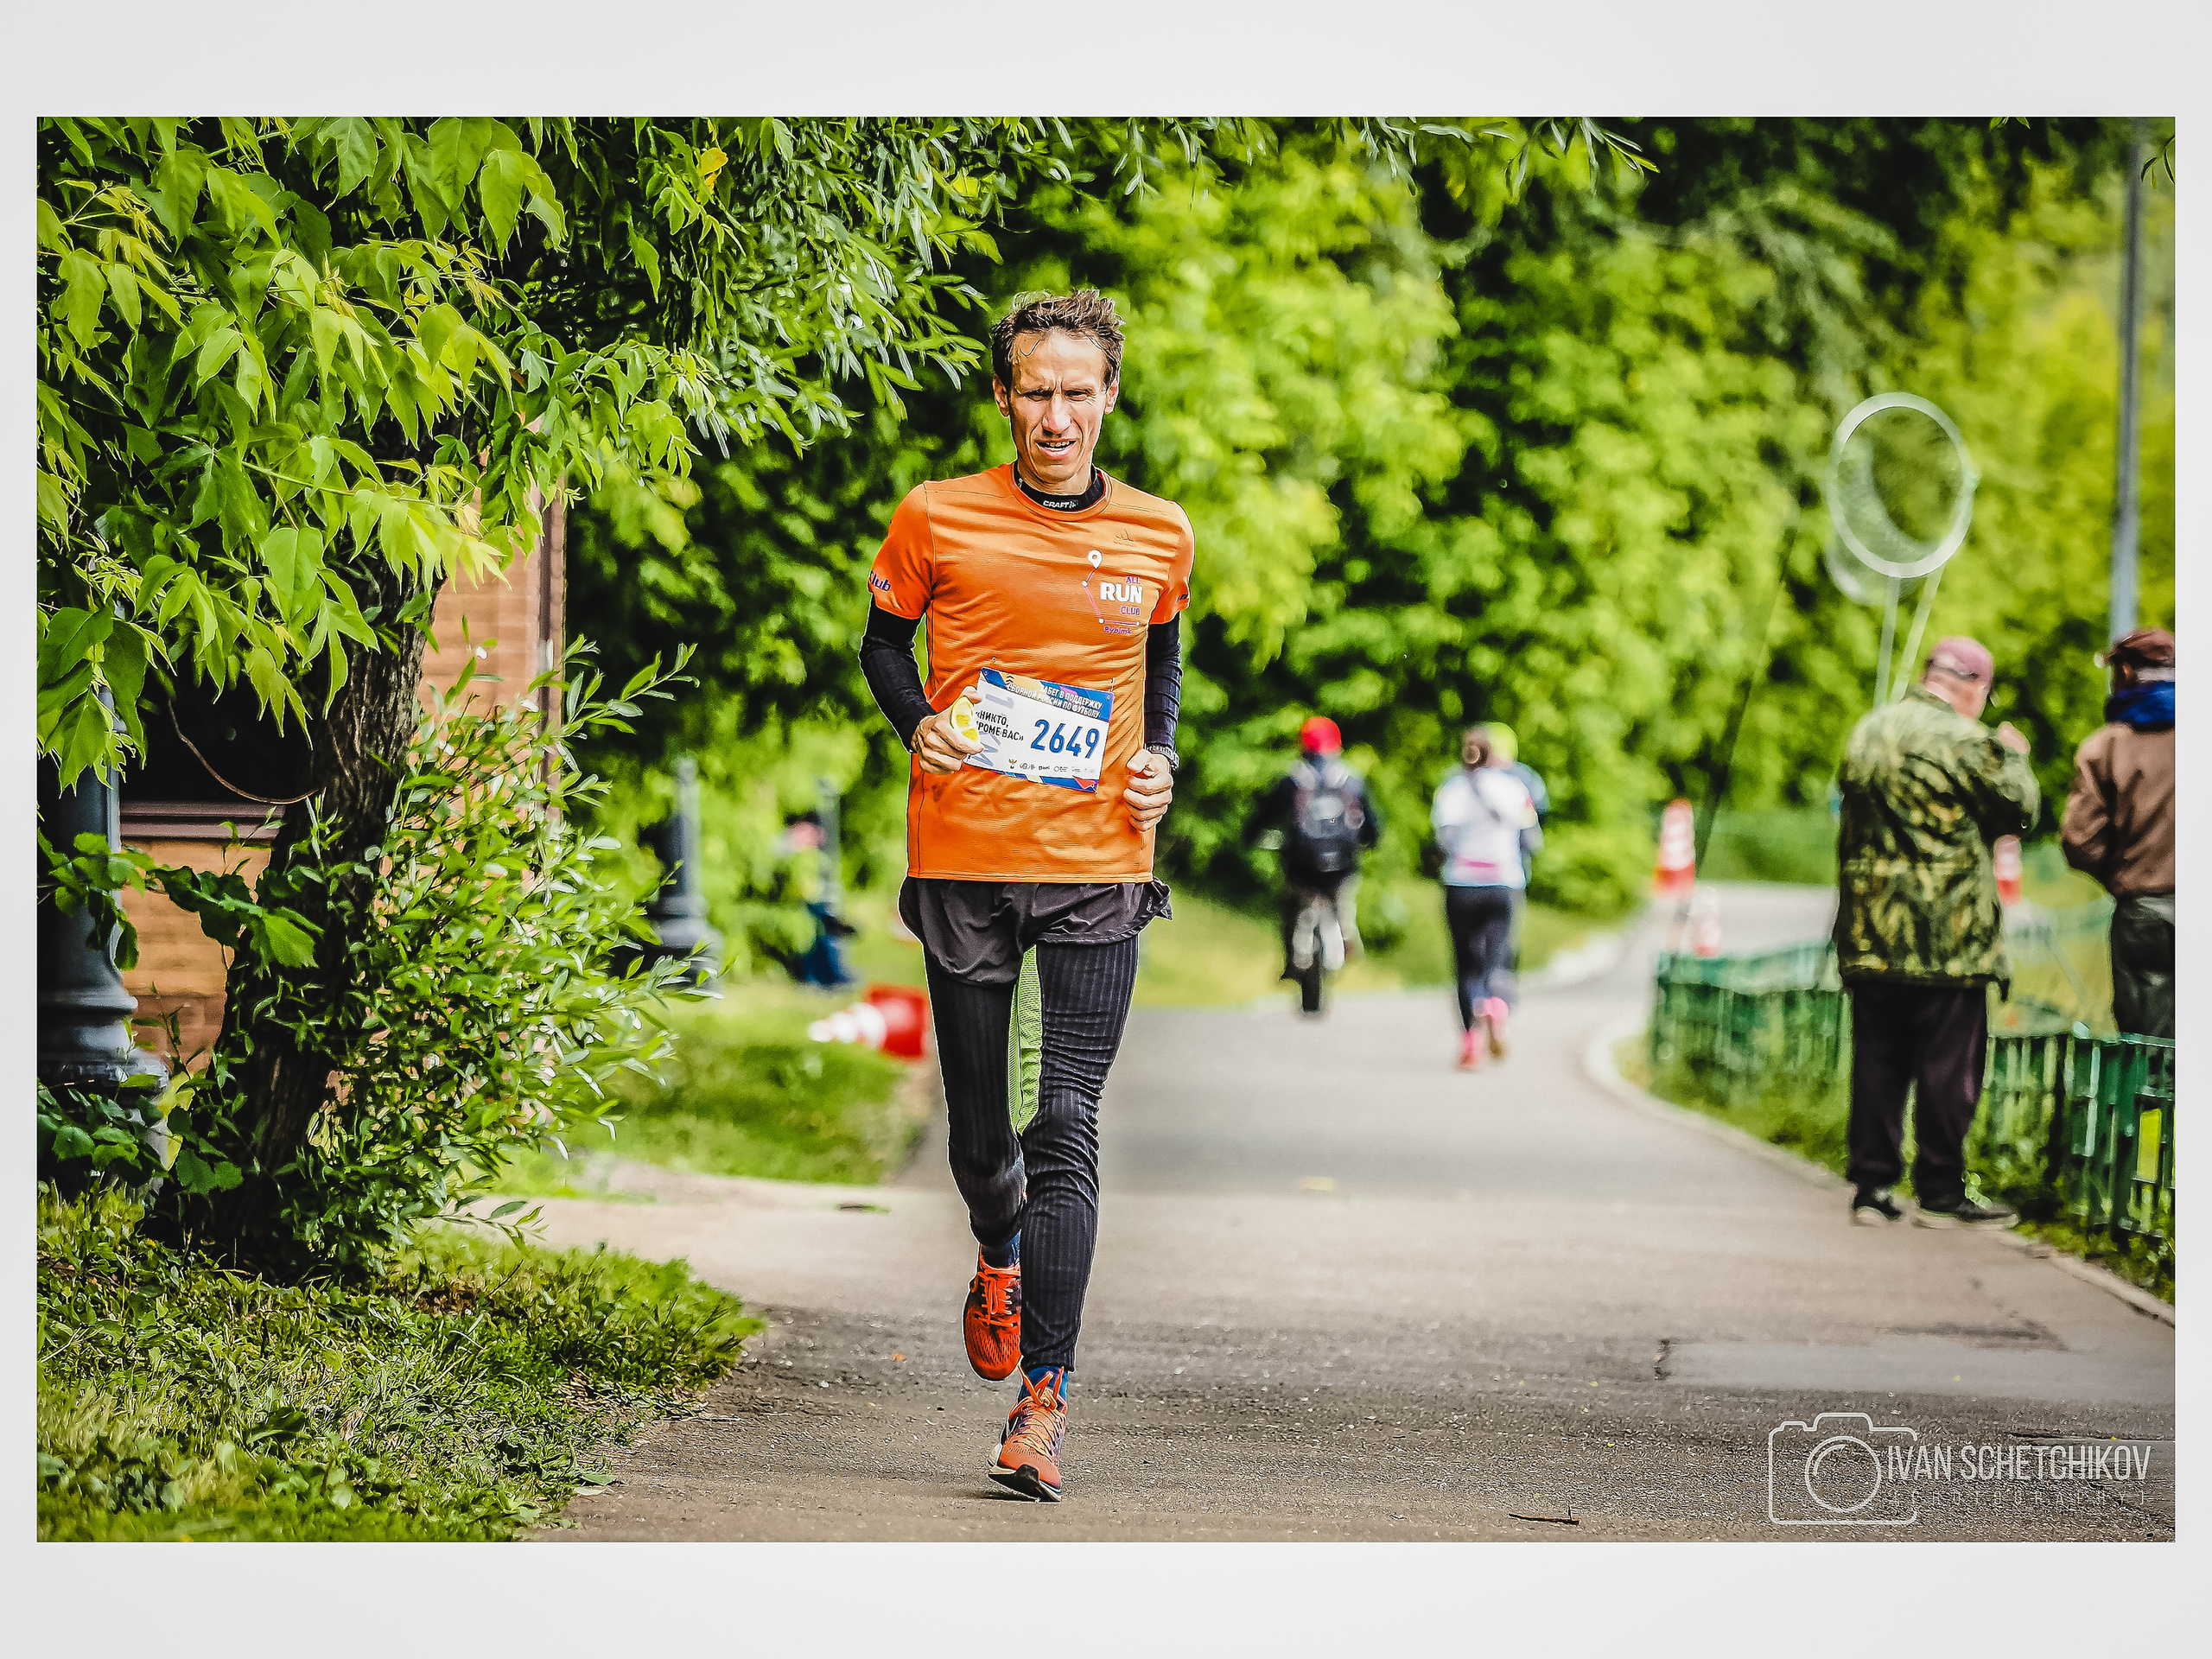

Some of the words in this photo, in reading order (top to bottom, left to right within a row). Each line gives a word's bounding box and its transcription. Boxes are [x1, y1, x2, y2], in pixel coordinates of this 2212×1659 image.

[1126, 575, 1141, 584] ALL
[1100, 582, 1142, 604] RUN
[1120, 606, 1140, 615] CLUB
[1058, 690, 1065, 699] В
[1065, 692, 1103, 710] ПОДДЕРЖКУ
[1063, 701, 1071, 710] ПО
[1071, 704, 1100, 718] ФУТБОЛУ
[976, 721, 1001, 736] РОМЕ
[1002, 728, 1023, 741] ВАС»
[1030, 719, 1100, 759] 2649
